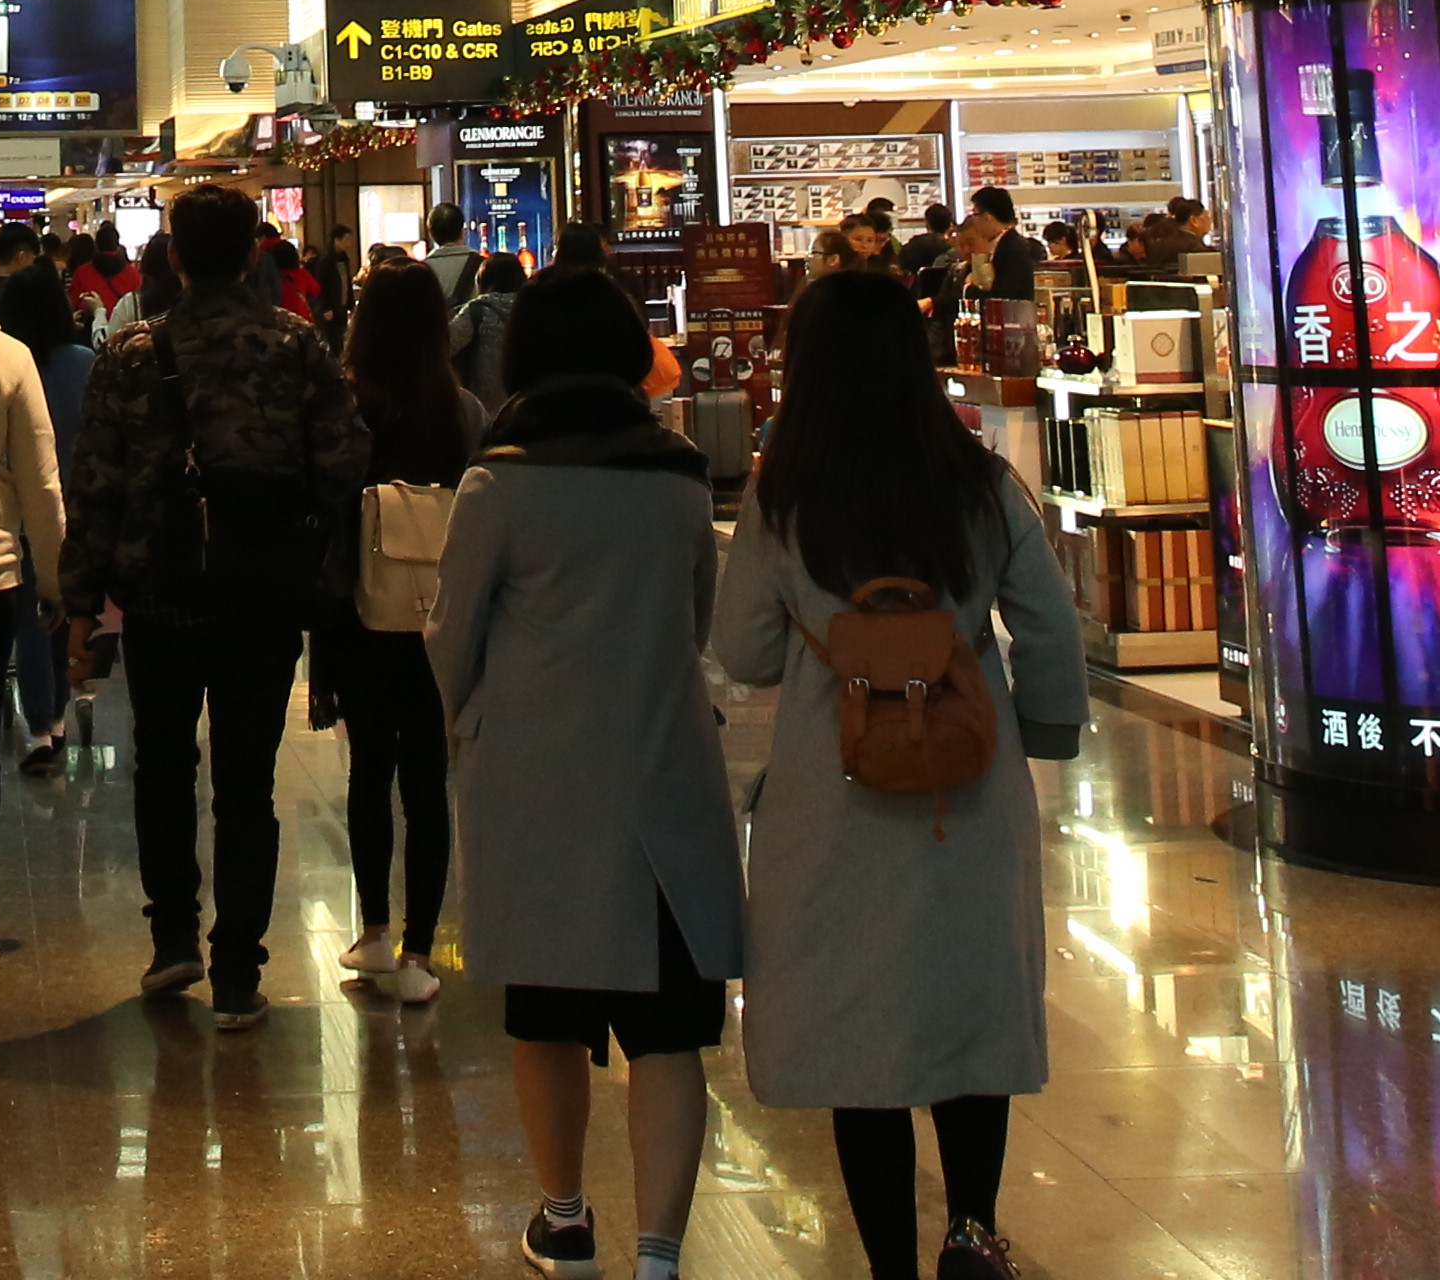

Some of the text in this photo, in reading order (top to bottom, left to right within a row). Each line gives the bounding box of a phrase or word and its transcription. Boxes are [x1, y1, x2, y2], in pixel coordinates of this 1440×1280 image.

[380, 18, 502, 39] 登機門 Gates
[380, 42, 499, 60] C1-C10 & C5R
[381, 64, 433, 81] B1-B9
[460, 125, 545, 142] GLENMORANGIE
